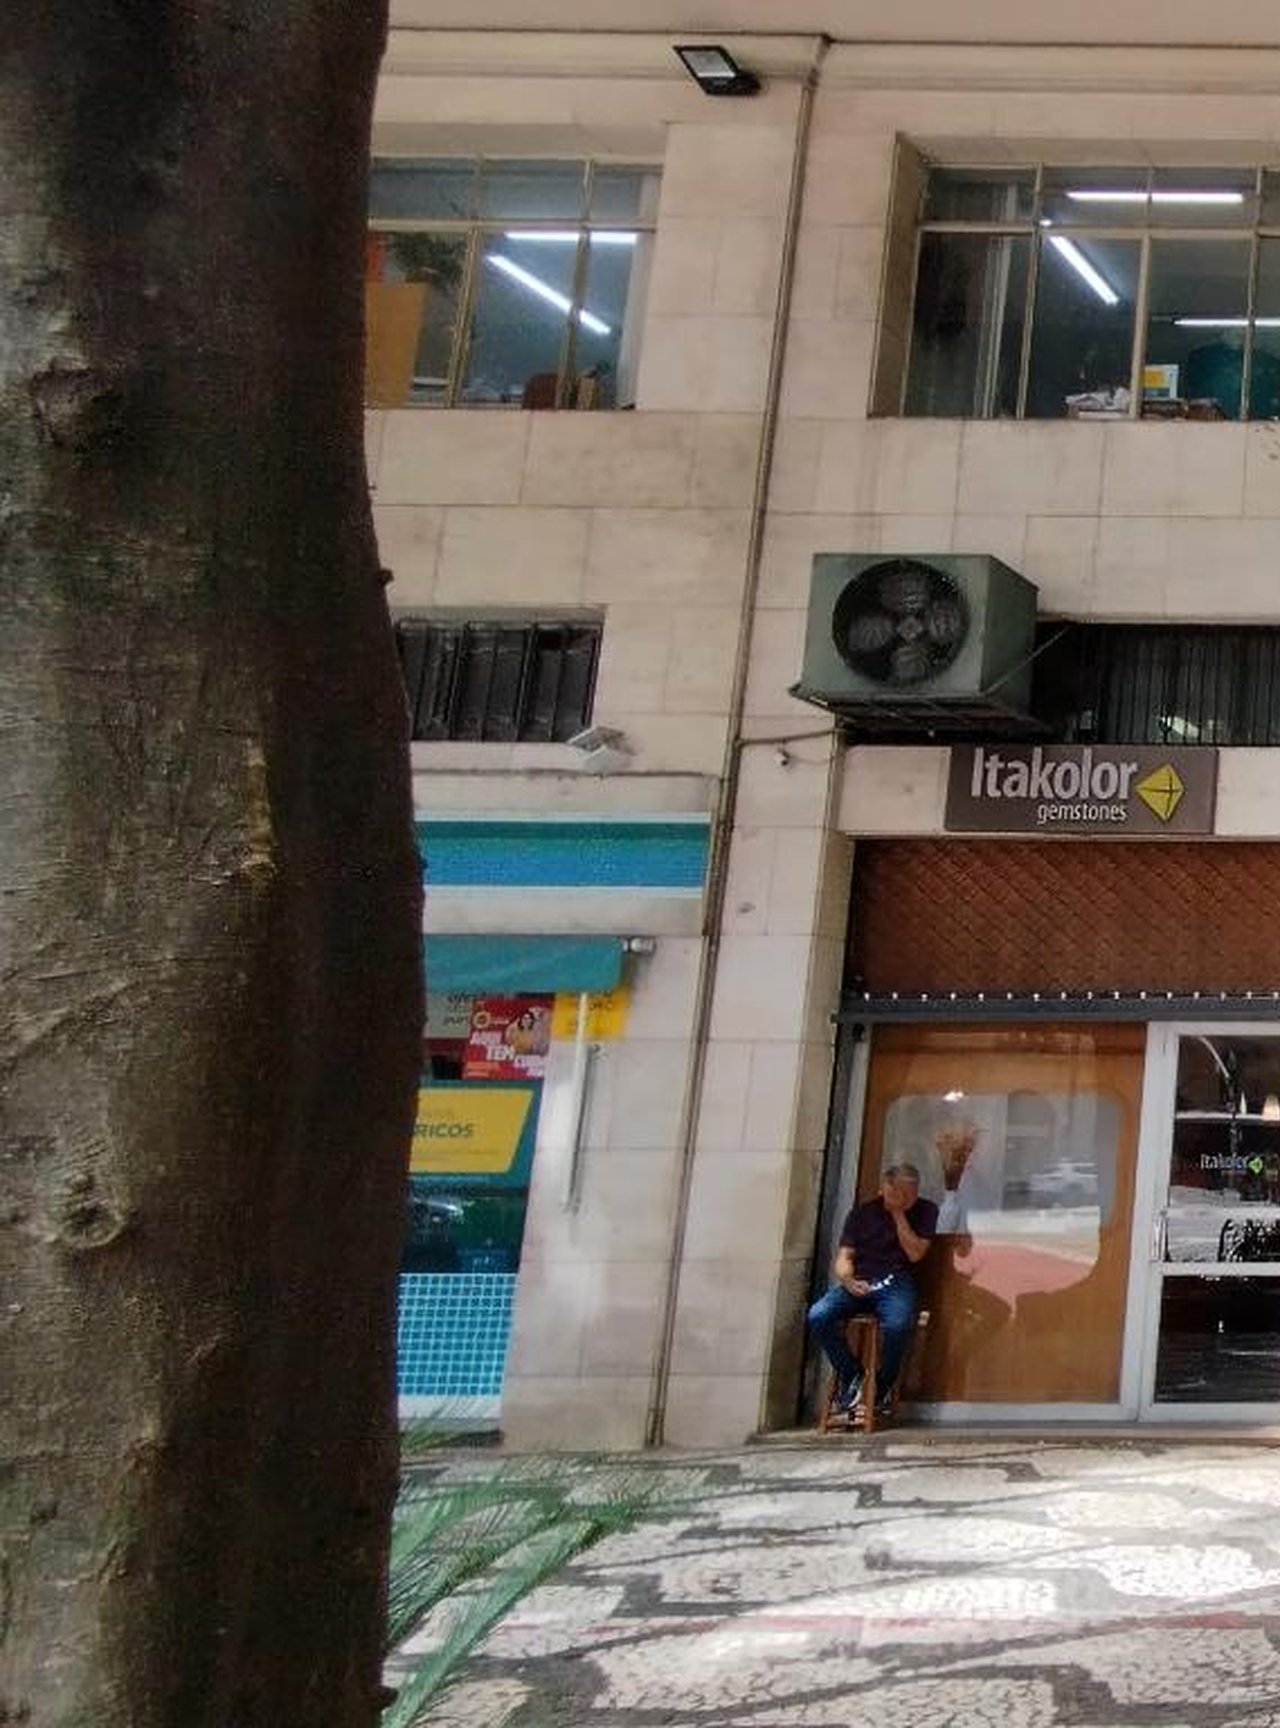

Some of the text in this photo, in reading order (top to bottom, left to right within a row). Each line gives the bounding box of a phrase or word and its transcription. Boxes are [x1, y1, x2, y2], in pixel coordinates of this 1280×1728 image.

[971, 747, 1139, 799] Itakolor
[1036, 803, 1127, 825] gemstones
[411, 1122, 476, 1138] RICOS
